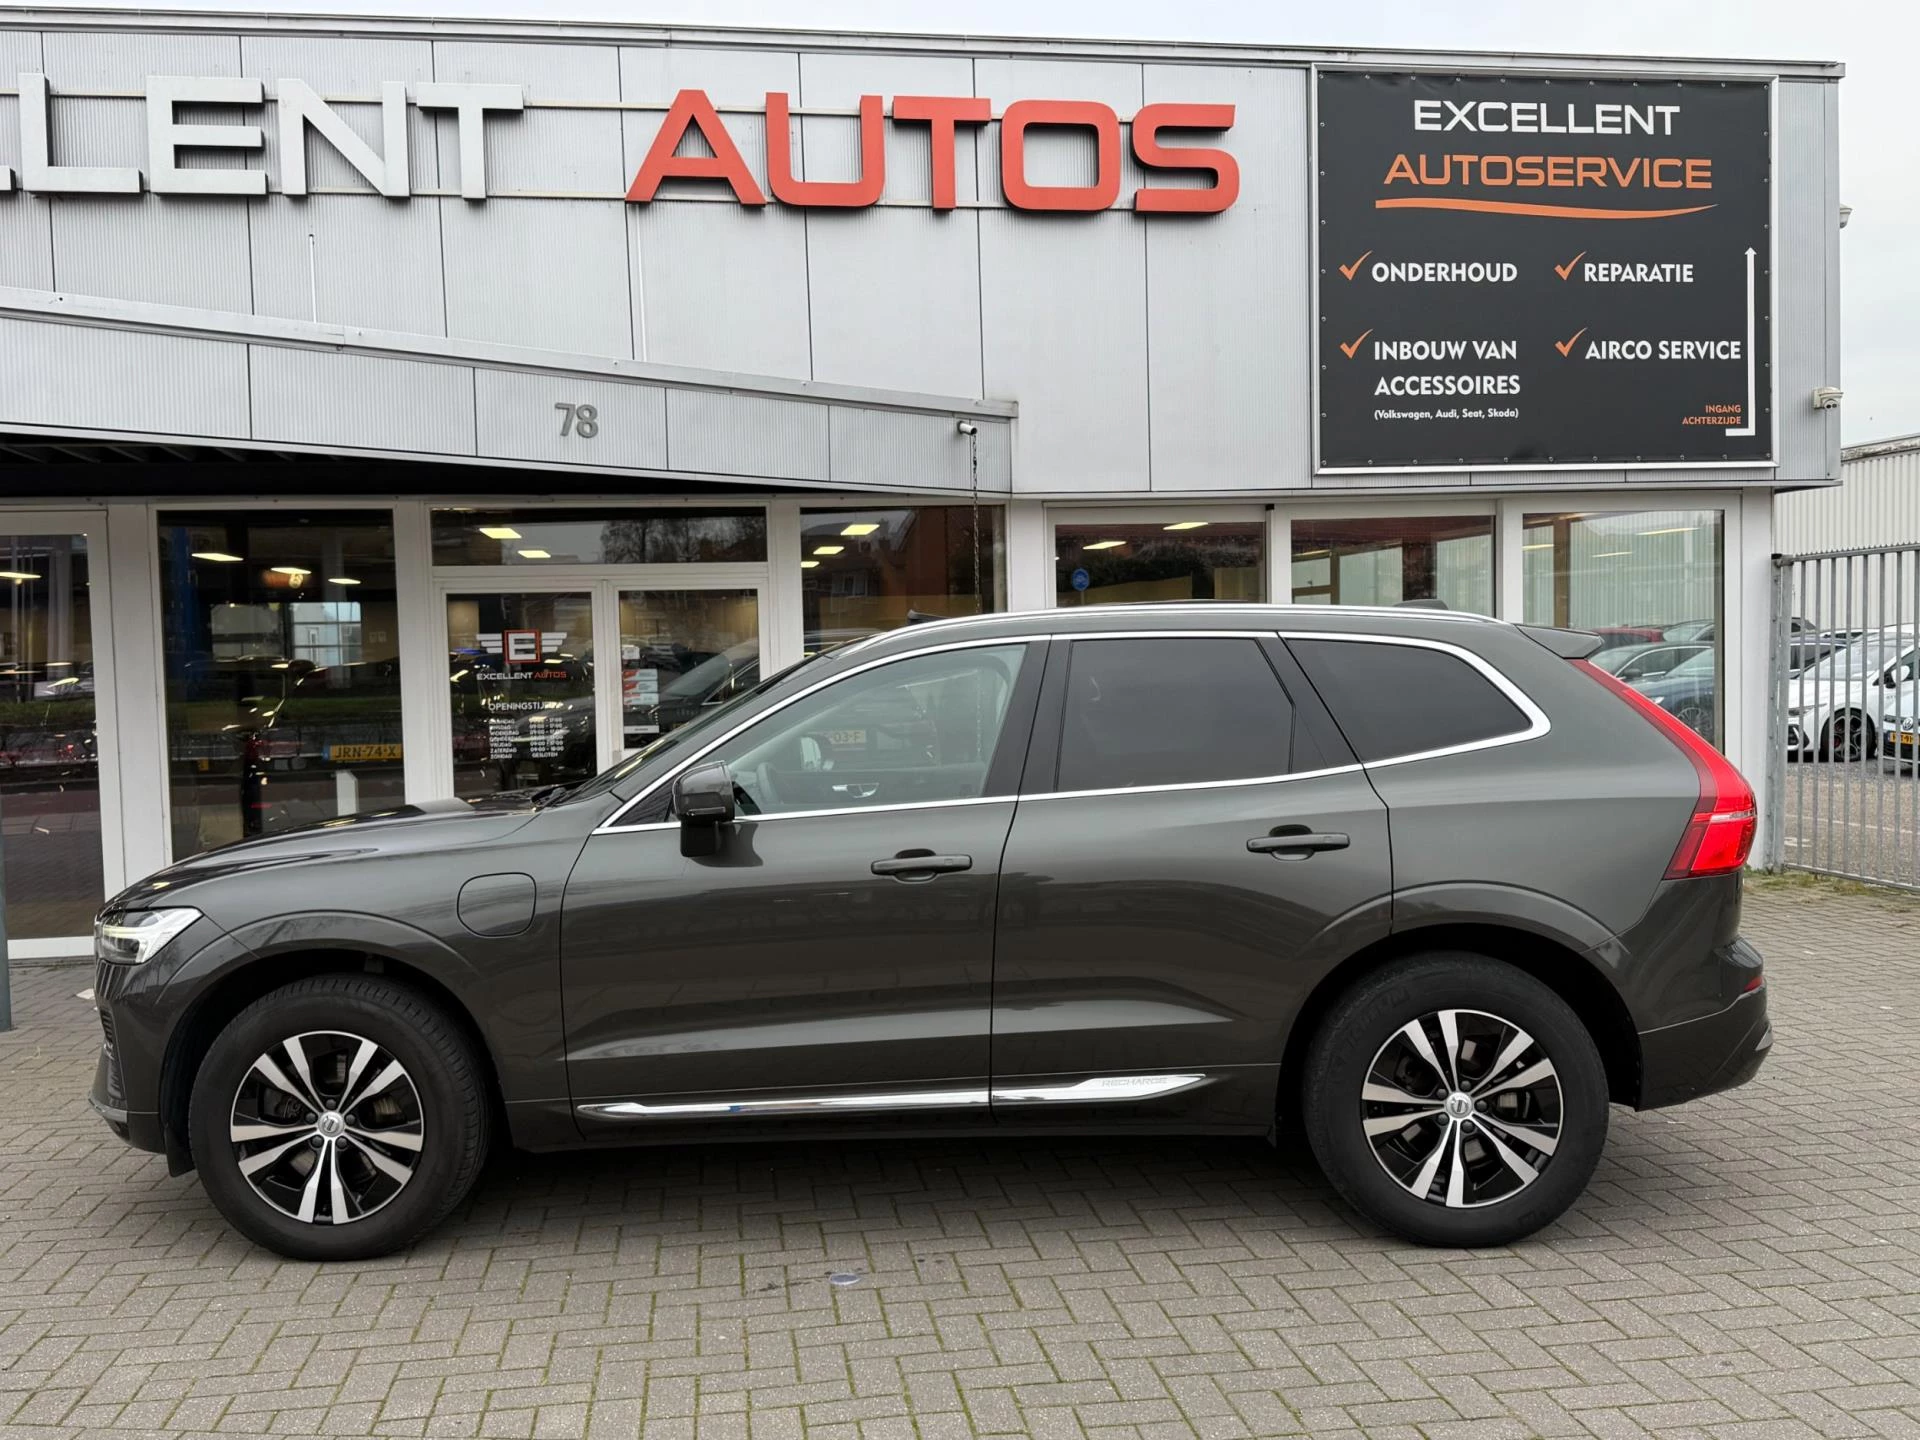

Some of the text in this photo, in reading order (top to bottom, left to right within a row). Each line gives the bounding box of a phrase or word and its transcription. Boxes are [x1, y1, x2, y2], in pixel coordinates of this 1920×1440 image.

[1413, 99, 1681, 135] EXCELLENT
[0, 73, 1240, 213] LENT AUTOS
[1383, 153, 1713, 189] AUTOSERVICE
[1371, 262, 1518, 283] ONDERHOUD
[1584, 263, 1694, 283] REPARATIE
[1374, 340, 1517, 361] INBOUW VAN
[1585, 340, 1741, 360] AIRCO SERVICE
[1374, 375, 1521, 396] ACCESSOIRES
[1374, 407, 1519, 420] (Volkswagen, Audi, Seat, Skoda)
[1705, 404, 1741, 413] INGANG
[555, 402, 599, 439] 78
[1682, 416, 1742, 425] ACHTERZIJDE
[508, 633, 537, 660] E
[476, 671, 567, 680] EXCELLENT AUTOS
[488, 701, 563, 711] OPENINGSTIJ
[1101, 1077, 1169, 1087] RECHARGE
